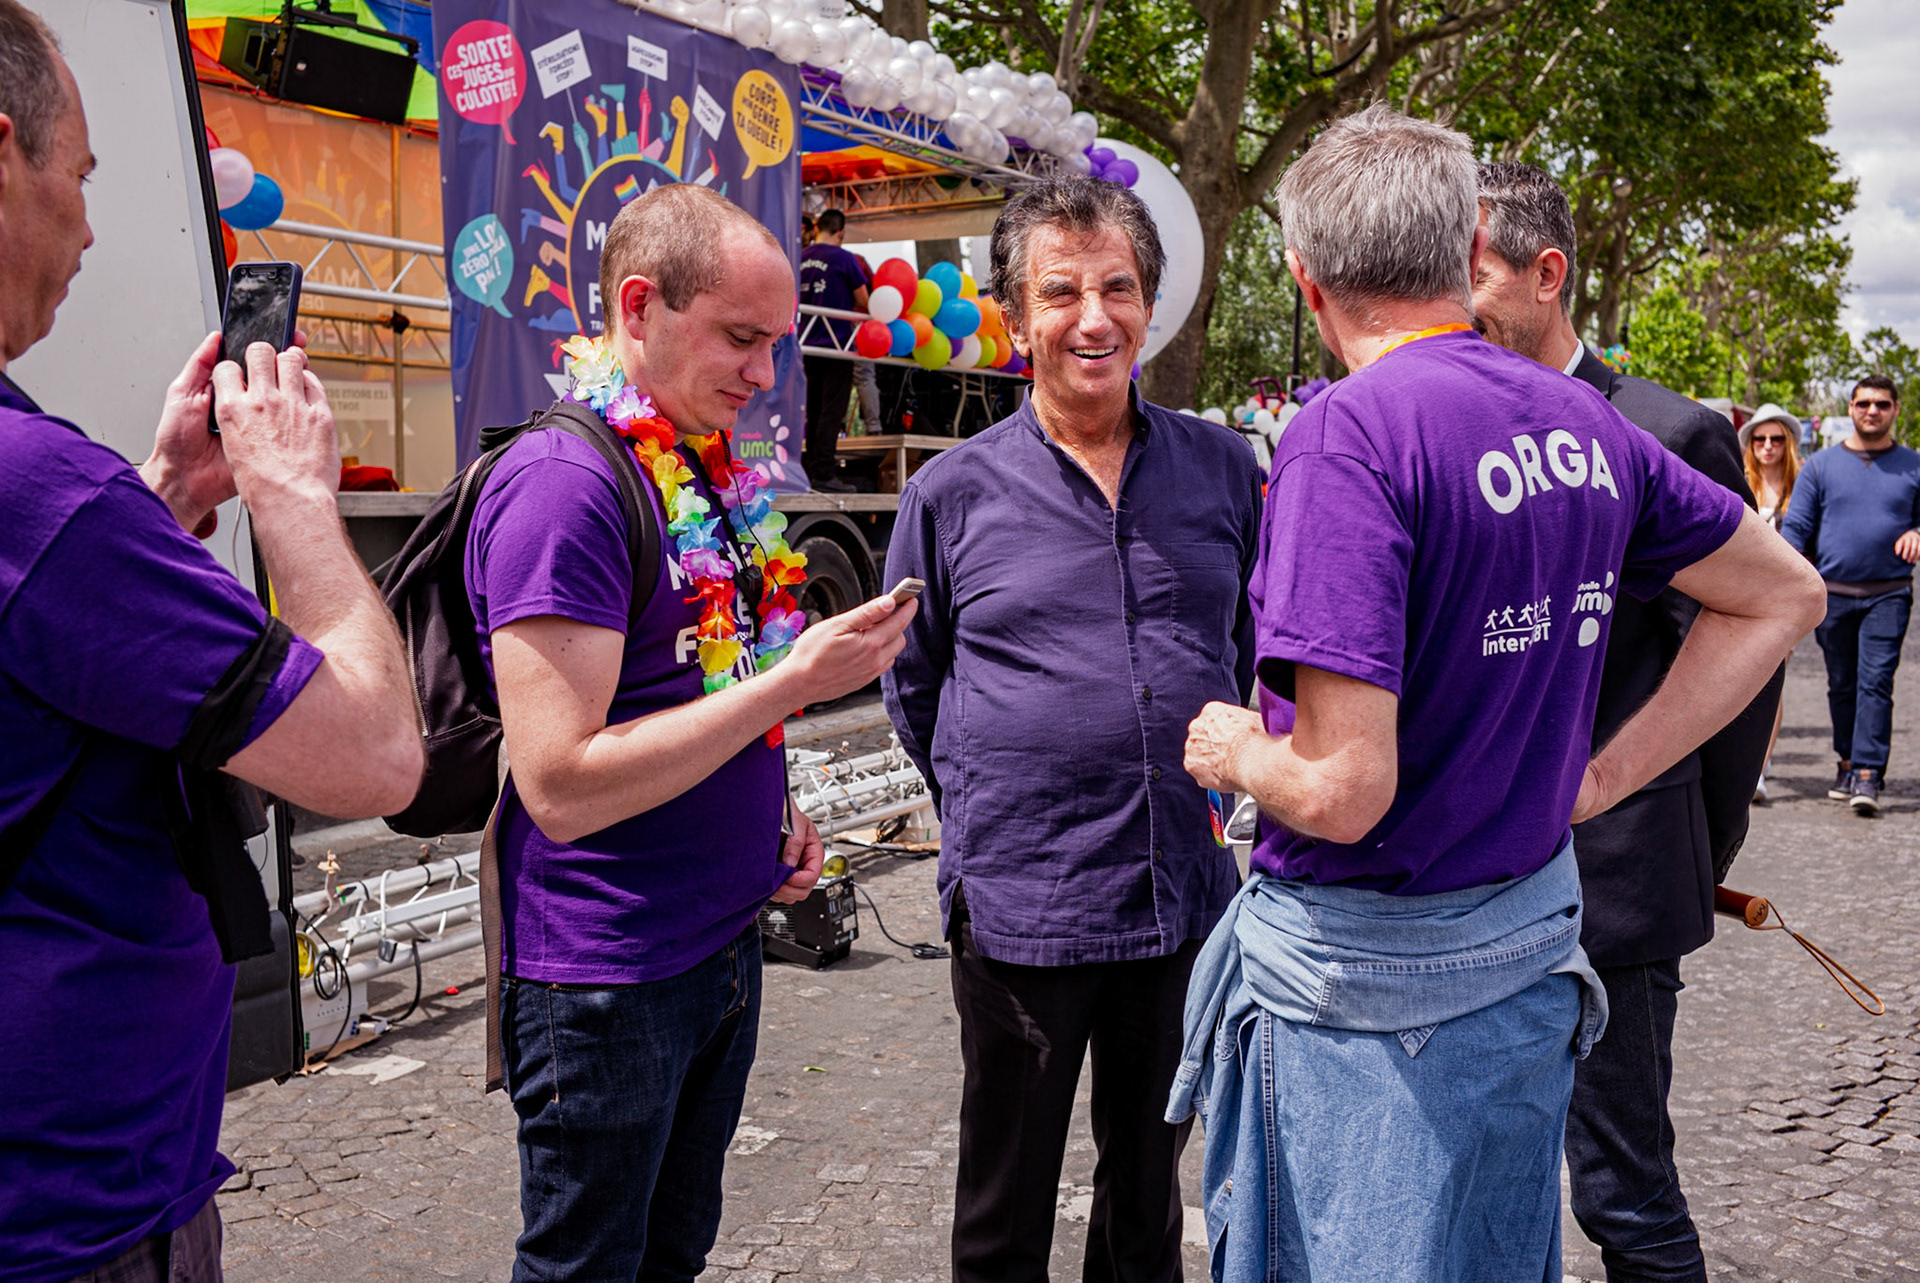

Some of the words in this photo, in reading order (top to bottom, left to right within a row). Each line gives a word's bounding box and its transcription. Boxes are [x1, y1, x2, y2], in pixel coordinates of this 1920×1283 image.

[463, 61, 504, 90] JUGES
[740, 440, 774, 459] umc
[1477, 429, 1620, 514] ORGA
